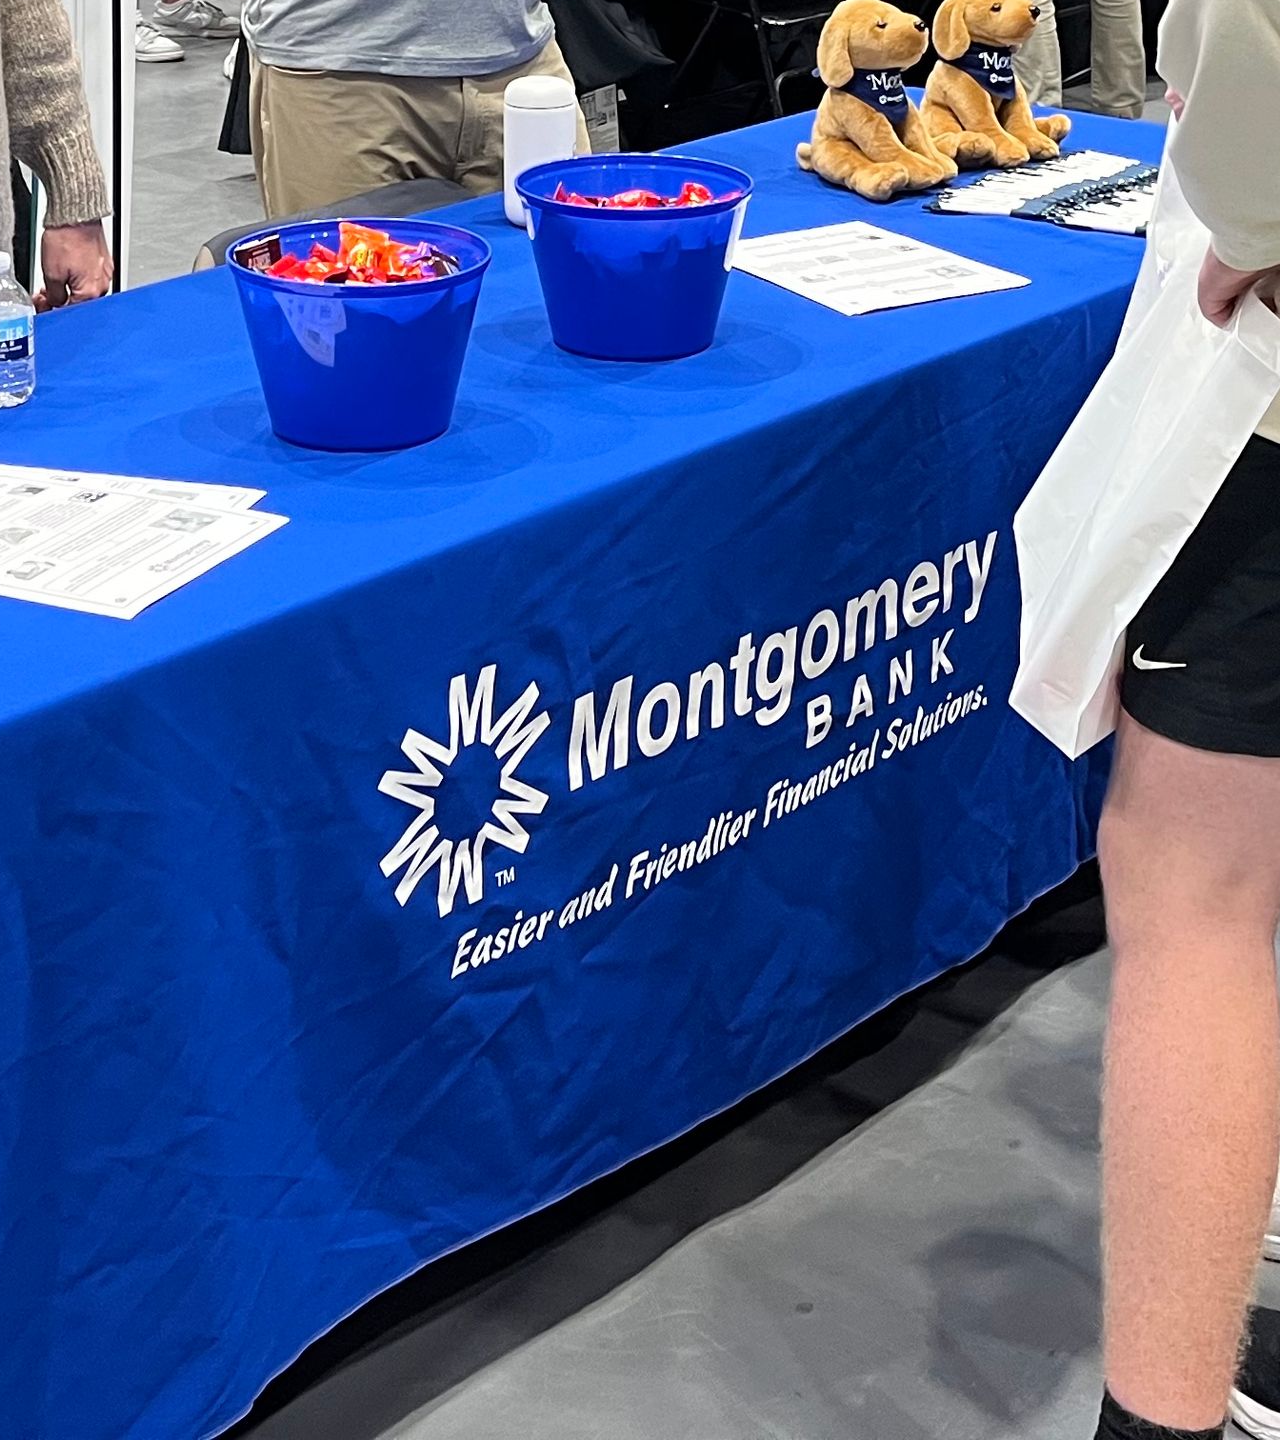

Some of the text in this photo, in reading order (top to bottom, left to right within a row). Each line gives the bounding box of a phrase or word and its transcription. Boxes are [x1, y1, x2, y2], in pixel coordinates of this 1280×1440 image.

[568, 530, 998, 791] Montgomery
[805, 628, 955, 748] BANK
[450, 681, 989, 979] Easier and Friendlier Financial Solutions.
[494, 868, 515, 887] TM
